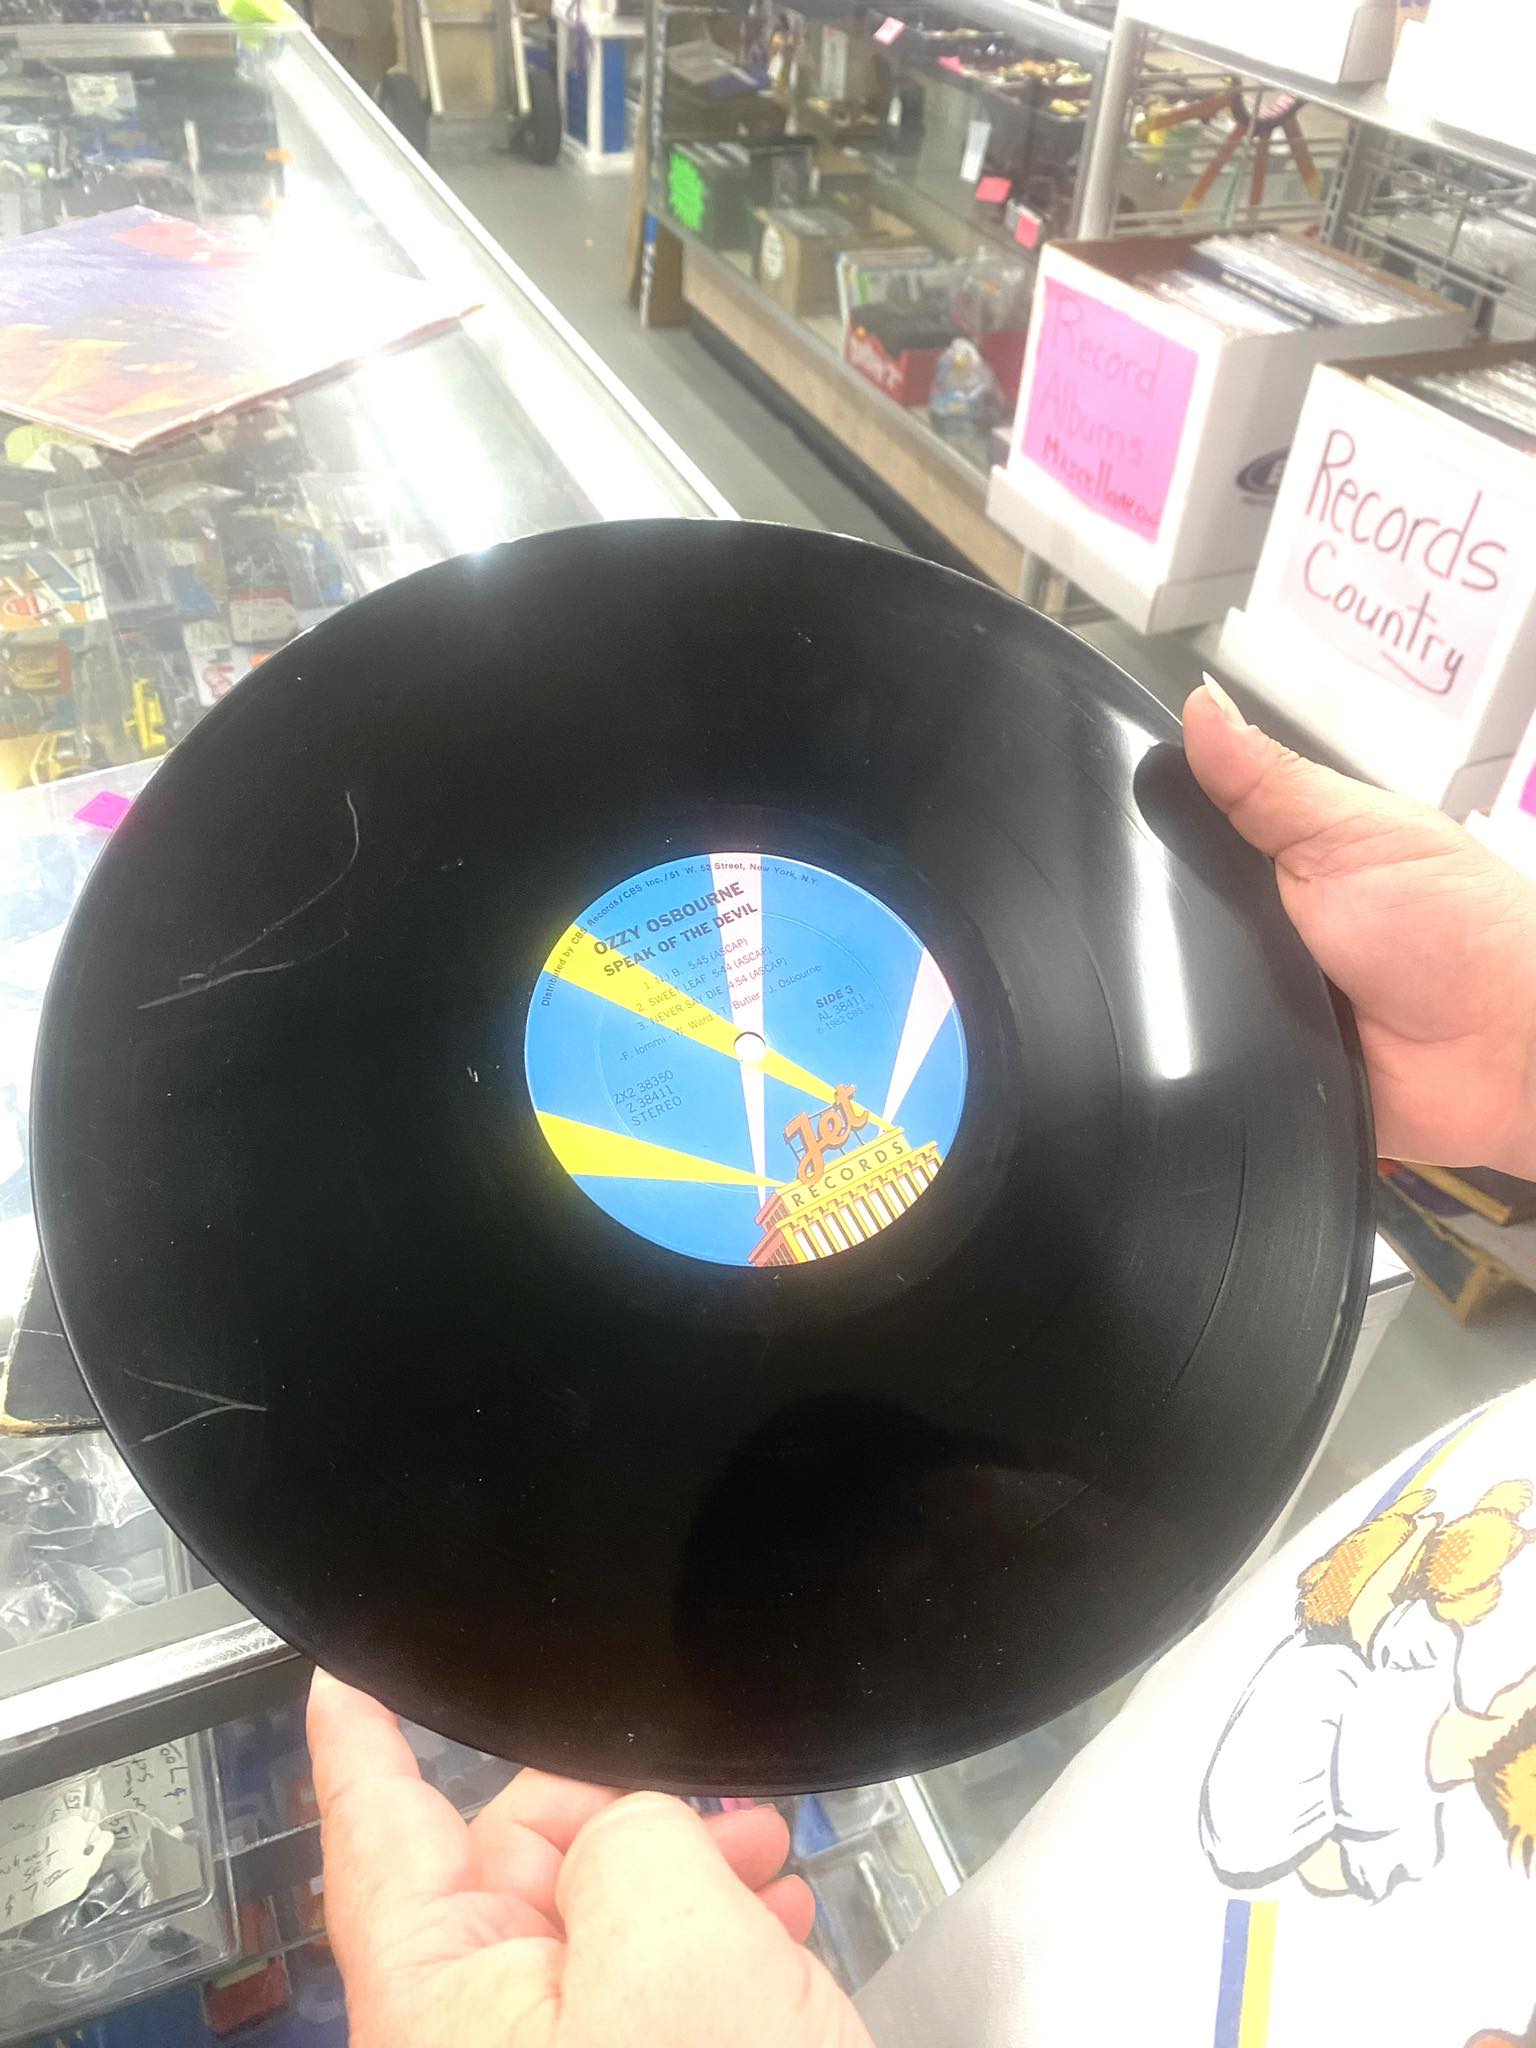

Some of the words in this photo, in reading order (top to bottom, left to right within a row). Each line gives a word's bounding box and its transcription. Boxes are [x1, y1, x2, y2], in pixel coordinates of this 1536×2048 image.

[1052, 296, 1163, 400] Record
[1038, 368, 1144, 467] Albums
[1304, 428, 1507, 593] Records
[1302, 539, 1465, 696] Country
[541, 959, 567, 1006] Distributed
[564, 946, 575, 958] by
[571, 926, 588, 945] CBS
[685, 865, 697, 875] W.
[700, 864, 711, 872] 52
[714, 862, 746, 871] Street,
[749, 863, 770, 872] New
[774, 866, 798, 880] York,
[593, 924, 641, 955] OZZY
[645, 881, 744, 933] OSBOURNE
[603, 947, 656, 977] SPEAK
[657, 936, 678, 953] OF
[679, 922, 713, 943] THE
[712, 903, 758, 929] DEVIL
[710, 937, 749, 960] (ASCAP)
[648, 986, 681, 1007] SWEET
[682, 974, 707, 992] LEAF
[734, 944, 773, 968] (ASCAP)
[650, 1005, 684, 1025] NEVER
[685, 994, 704, 1010] SAY
[705, 985, 723, 1000] DIE
[749, 957, 788, 980] (ASCAP)
[732, 992, 761, 1010] Butler
[768, 984, 777, 994] J.
[816, 989, 844, 1008] SIDE
[845, 985, 854, 994] 3
[818, 1011, 833, 1022] AL
[833, 993, 866, 1015] 38411
[613, 1086, 637, 1105] ZX2
[637, 1069, 674, 1093] 38350
[626, 1103, 635, 1113] Z
[637, 1086, 674, 1109] 38411
[631, 1095, 682, 1127] STEREO
[784, 1083, 870, 1186] Jet
[791, 1141, 904, 1207] RECORDS
